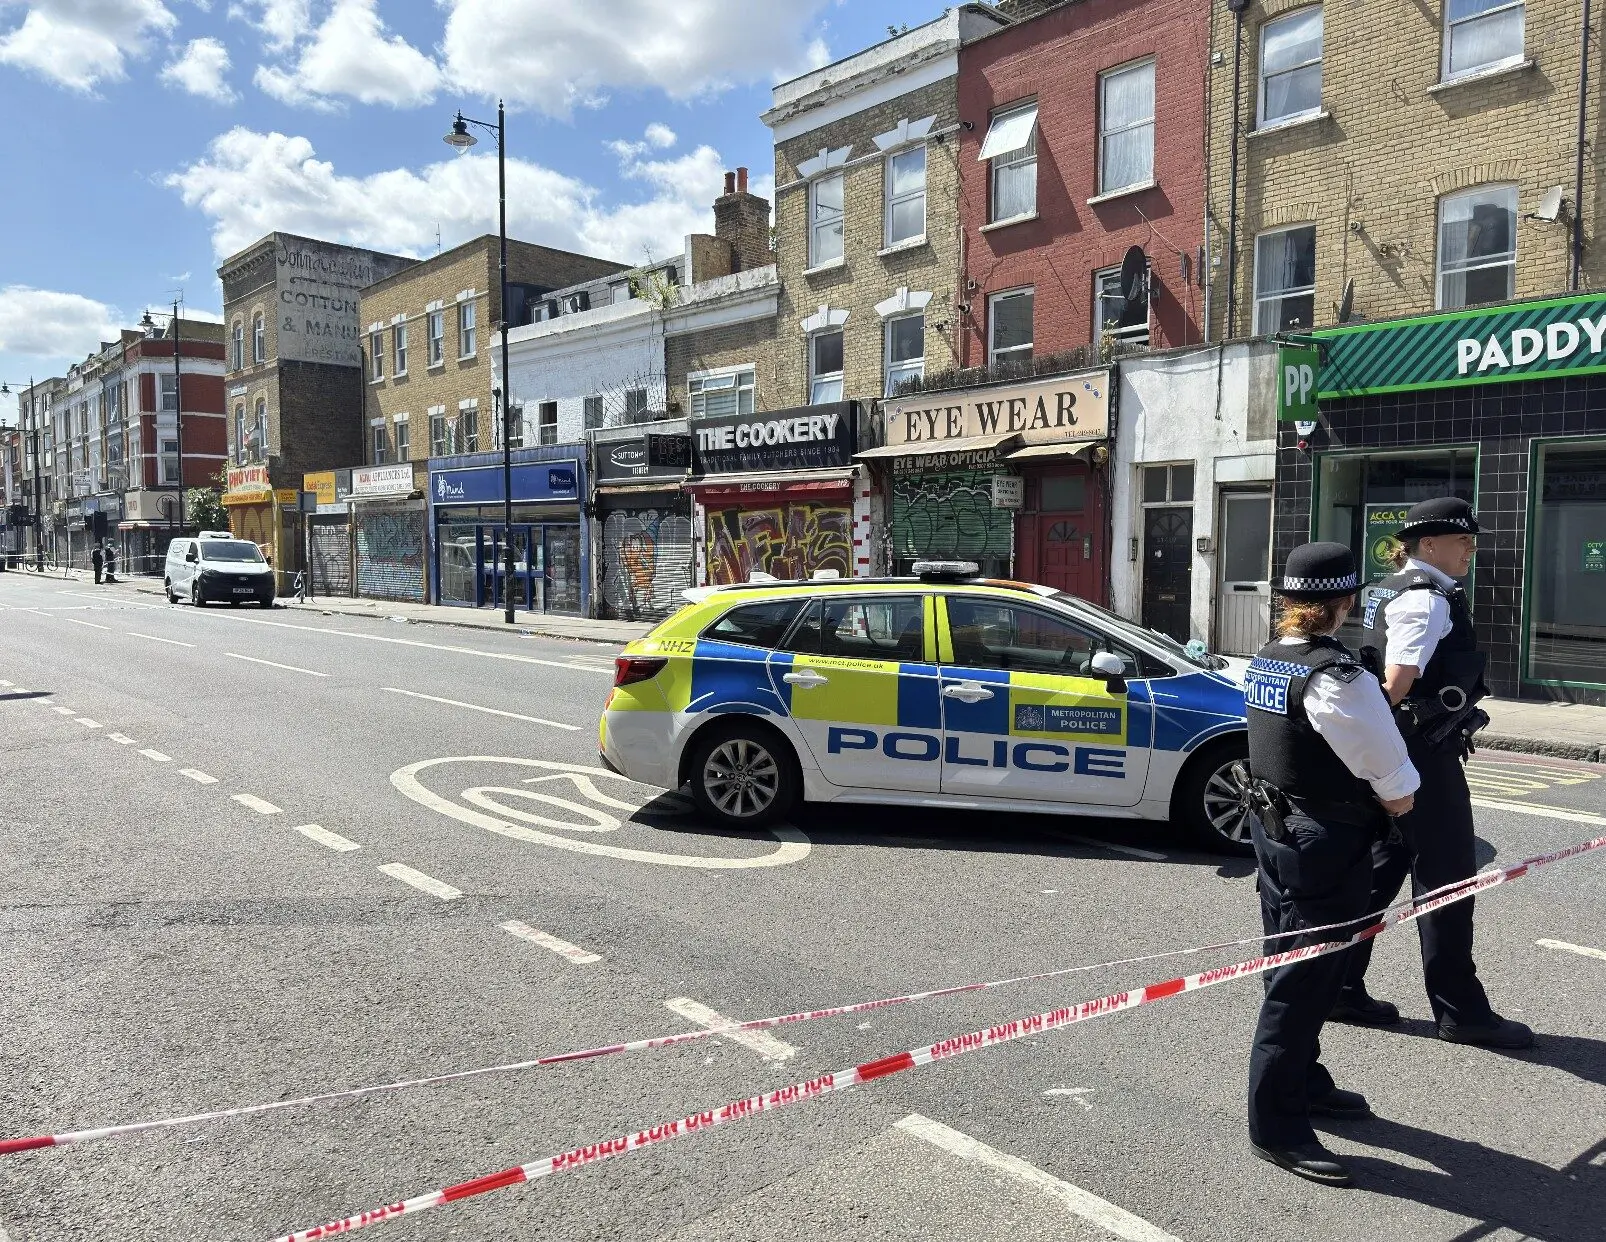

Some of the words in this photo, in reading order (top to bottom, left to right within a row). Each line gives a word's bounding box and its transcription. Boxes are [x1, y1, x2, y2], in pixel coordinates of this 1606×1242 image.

[281, 289, 357, 314] COTTON
[282, 316, 297, 333] &
[1458, 314, 1606, 374] PADDY
[1285, 364, 1313, 406] PP
[904, 406, 962, 442] EYE
[975, 391, 1079, 433] WEAR
[696, 425, 735, 451] THE
[736, 413, 841, 448] COOKERY
[617, 452, 639, 460] SUTTON
[739, 452, 761, 462] FAMILY
[800, 447, 821, 456] SINCE
[893, 457, 912, 469] EYE
[915, 454, 947, 467] WEAR
[740, 483, 752, 491] THE
[752, 482, 781, 491] COOKERY
[1369, 511, 1396, 521] ACCA
[658, 640, 695, 653] NHZ
[1244, 681, 1285, 709] POLICE
[1051, 709, 1116, 719] METROPOLITAN
[1060, 719, 1107, 730] POLICE
[827, 726, 1127, 779] POLICE
